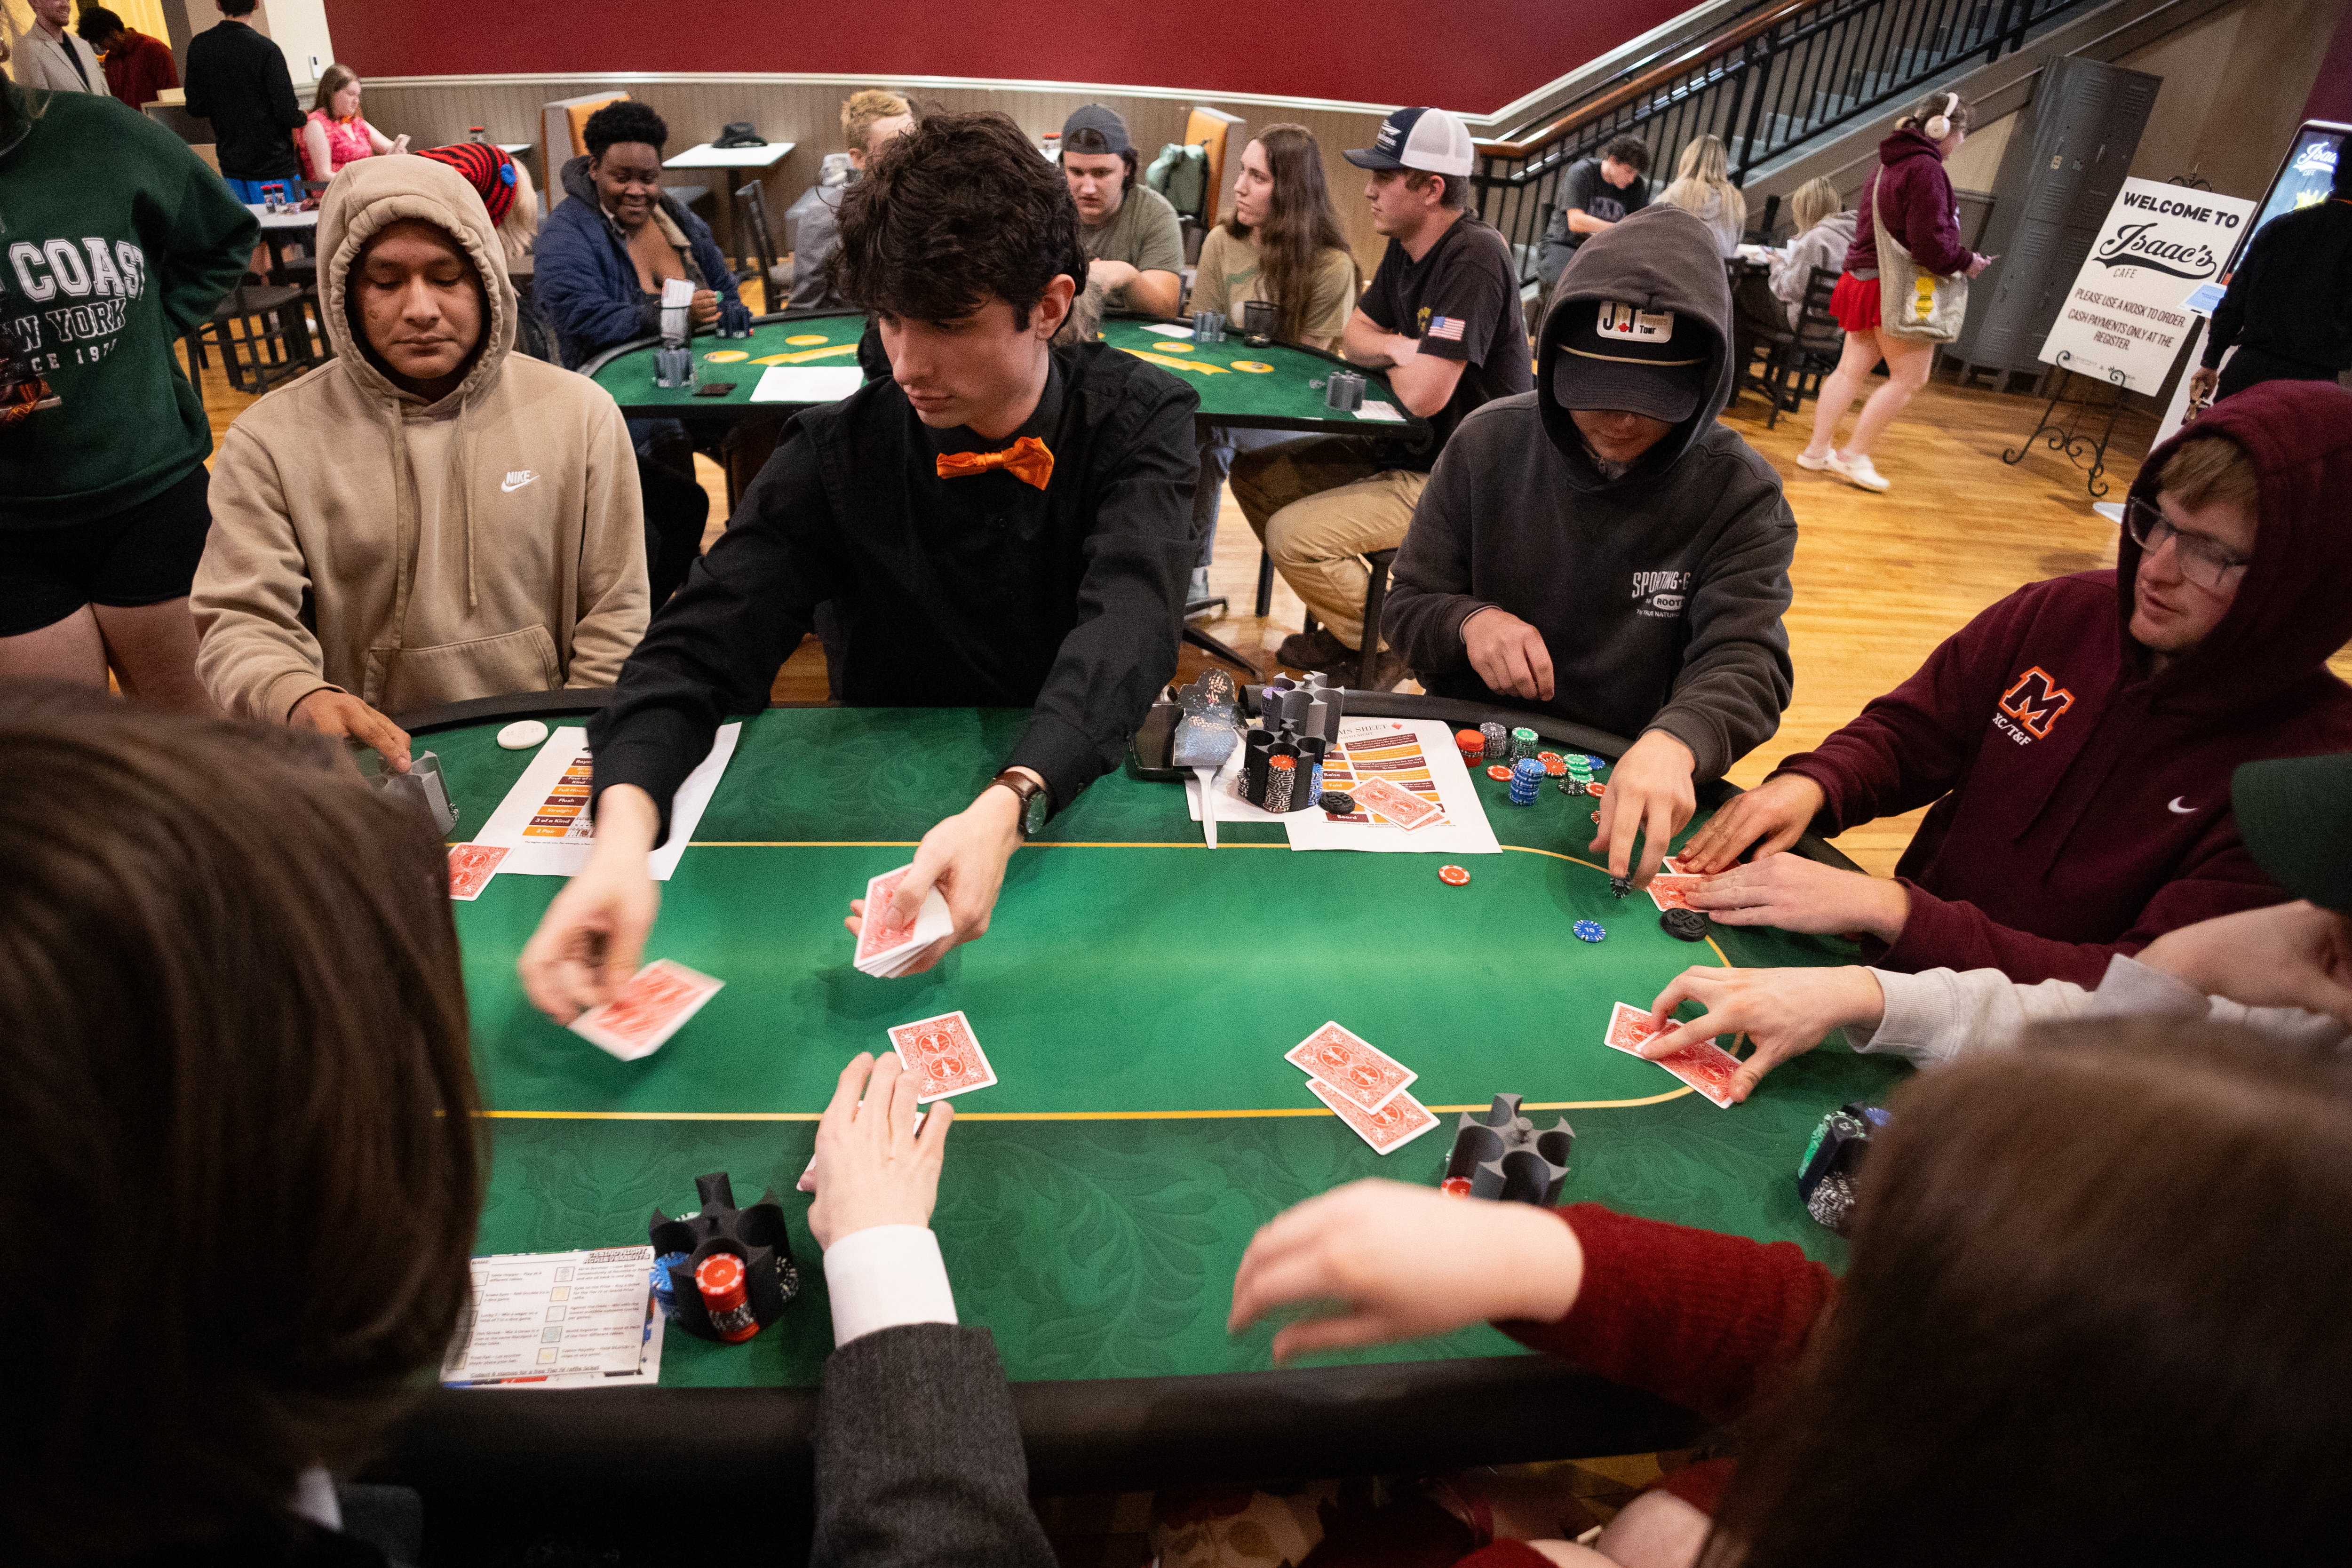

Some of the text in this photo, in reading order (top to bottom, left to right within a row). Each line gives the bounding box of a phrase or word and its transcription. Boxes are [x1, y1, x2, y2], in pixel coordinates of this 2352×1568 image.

[2124, 192, 2240, 228] WELCOME TO
[2099, 223, 2216, 267] Isaac's
[2113, 268, 2137, 279] CAFE
[46, 297, 126, 342] YORK
[2075, 288, 2185, 328] PLEASE USE A KIOSK TO ORDER.
[2068, 309, 2175, 348] CASH PAYMENTS ONLY AT THE
[2094, 330, 2130, 350] REGISTER.
[506, 470, 531, 484] NIKE
[1998, 666, 2075, 740] M
[1992, 713, 2031, 745] XC/T&F
